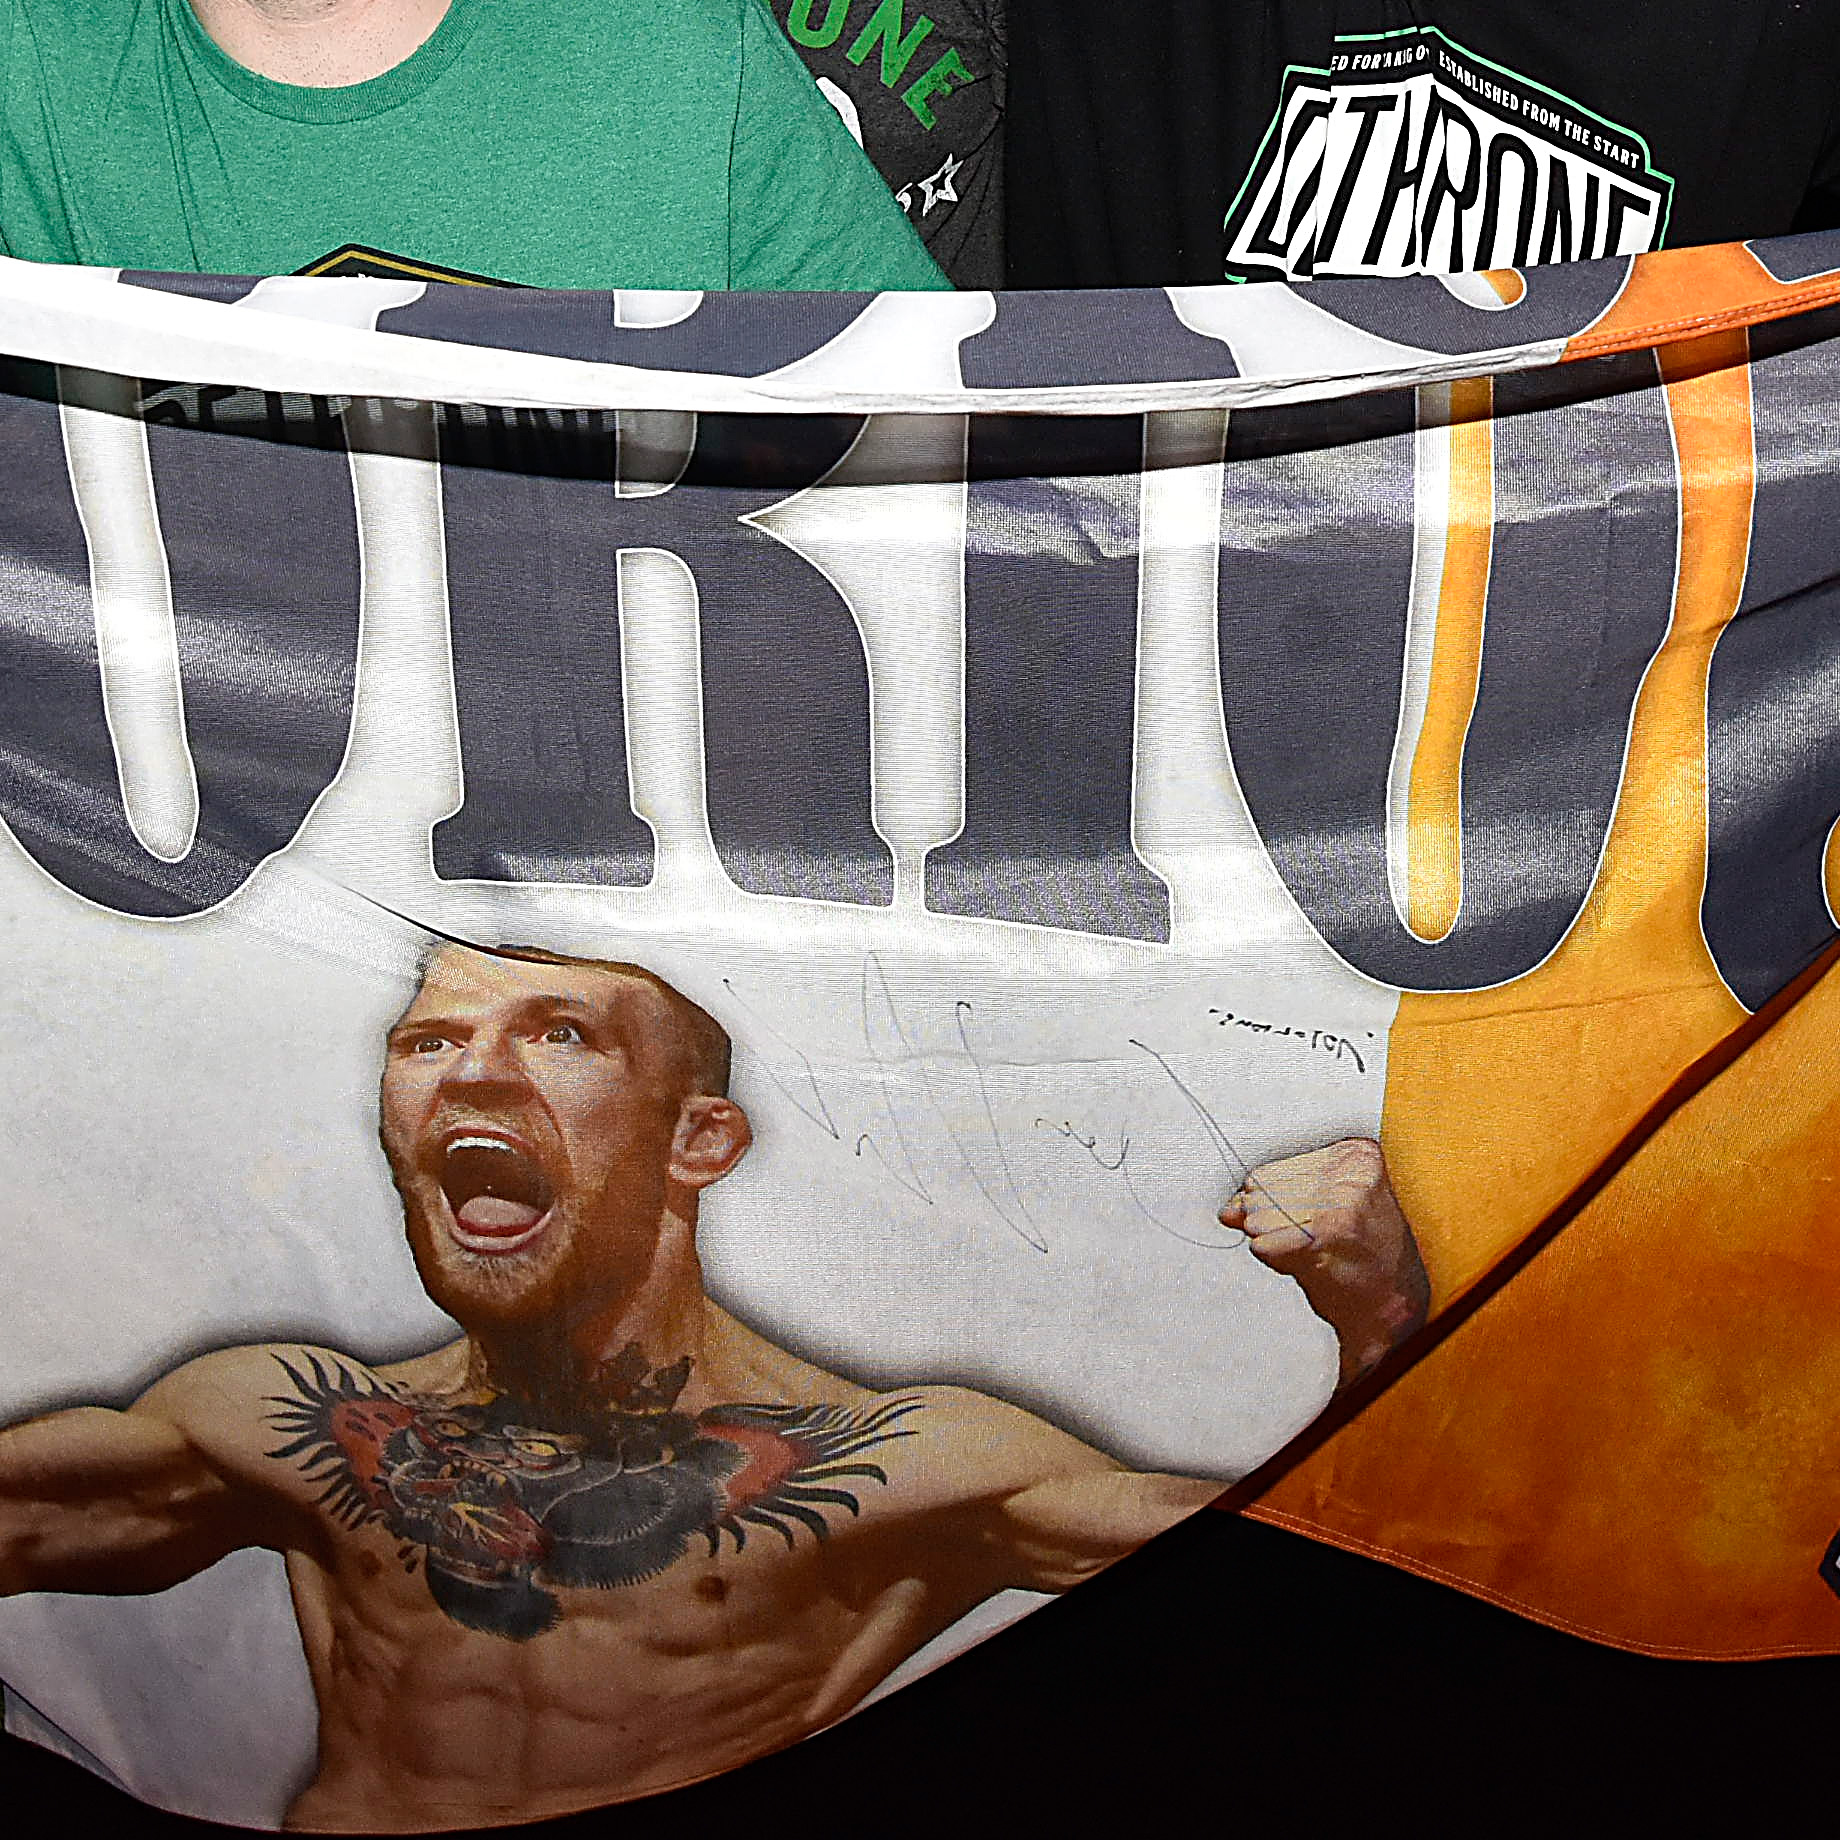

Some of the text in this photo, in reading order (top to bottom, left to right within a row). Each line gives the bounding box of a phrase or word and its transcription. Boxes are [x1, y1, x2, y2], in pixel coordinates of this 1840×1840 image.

[1439, 50, 1640, 169] ESTABLISHED FROM THE START
